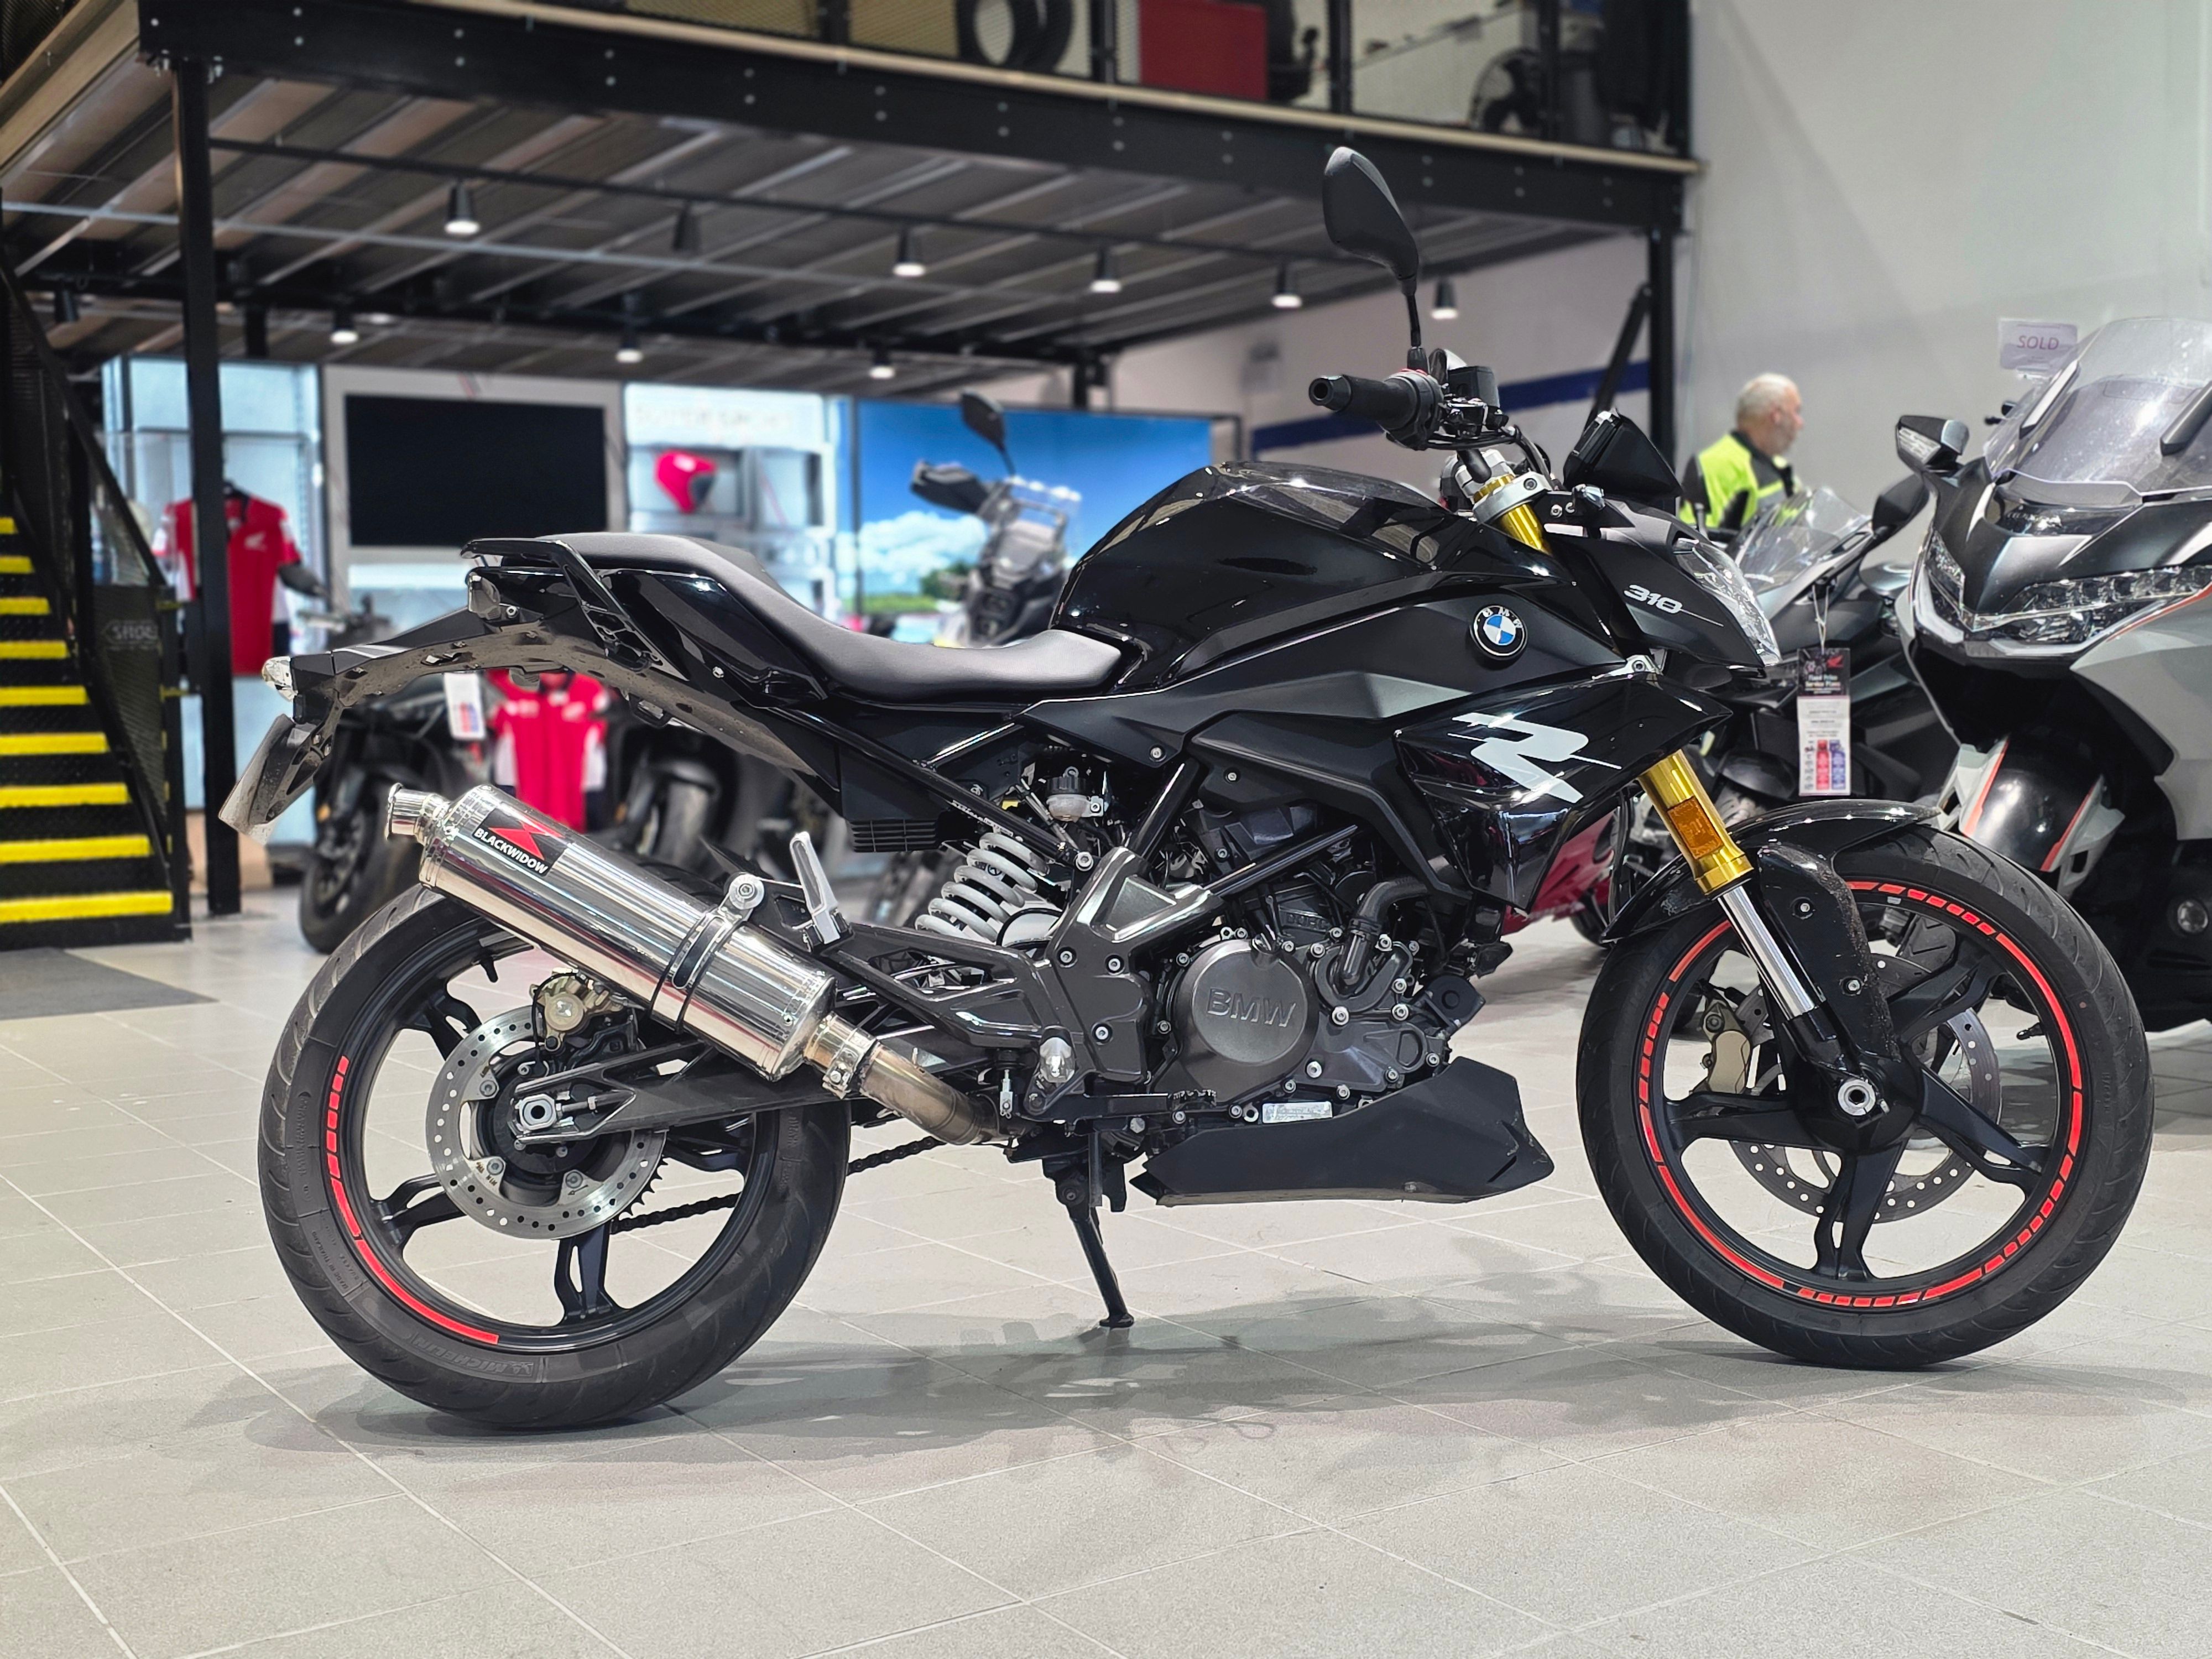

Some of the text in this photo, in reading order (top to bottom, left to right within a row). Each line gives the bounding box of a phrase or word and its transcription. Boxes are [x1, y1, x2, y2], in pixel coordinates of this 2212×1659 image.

[2017, 335, 2059, 350] SOLD
[1624, 585, 1683, 614] 310
[1448, 712, 1593, 803] R
[474, 828, 549, 874] BLACKWIDOW
[1207, 987, 1296, 1027] BMW
[413, 1336, 508, 1374] MICHELIN
